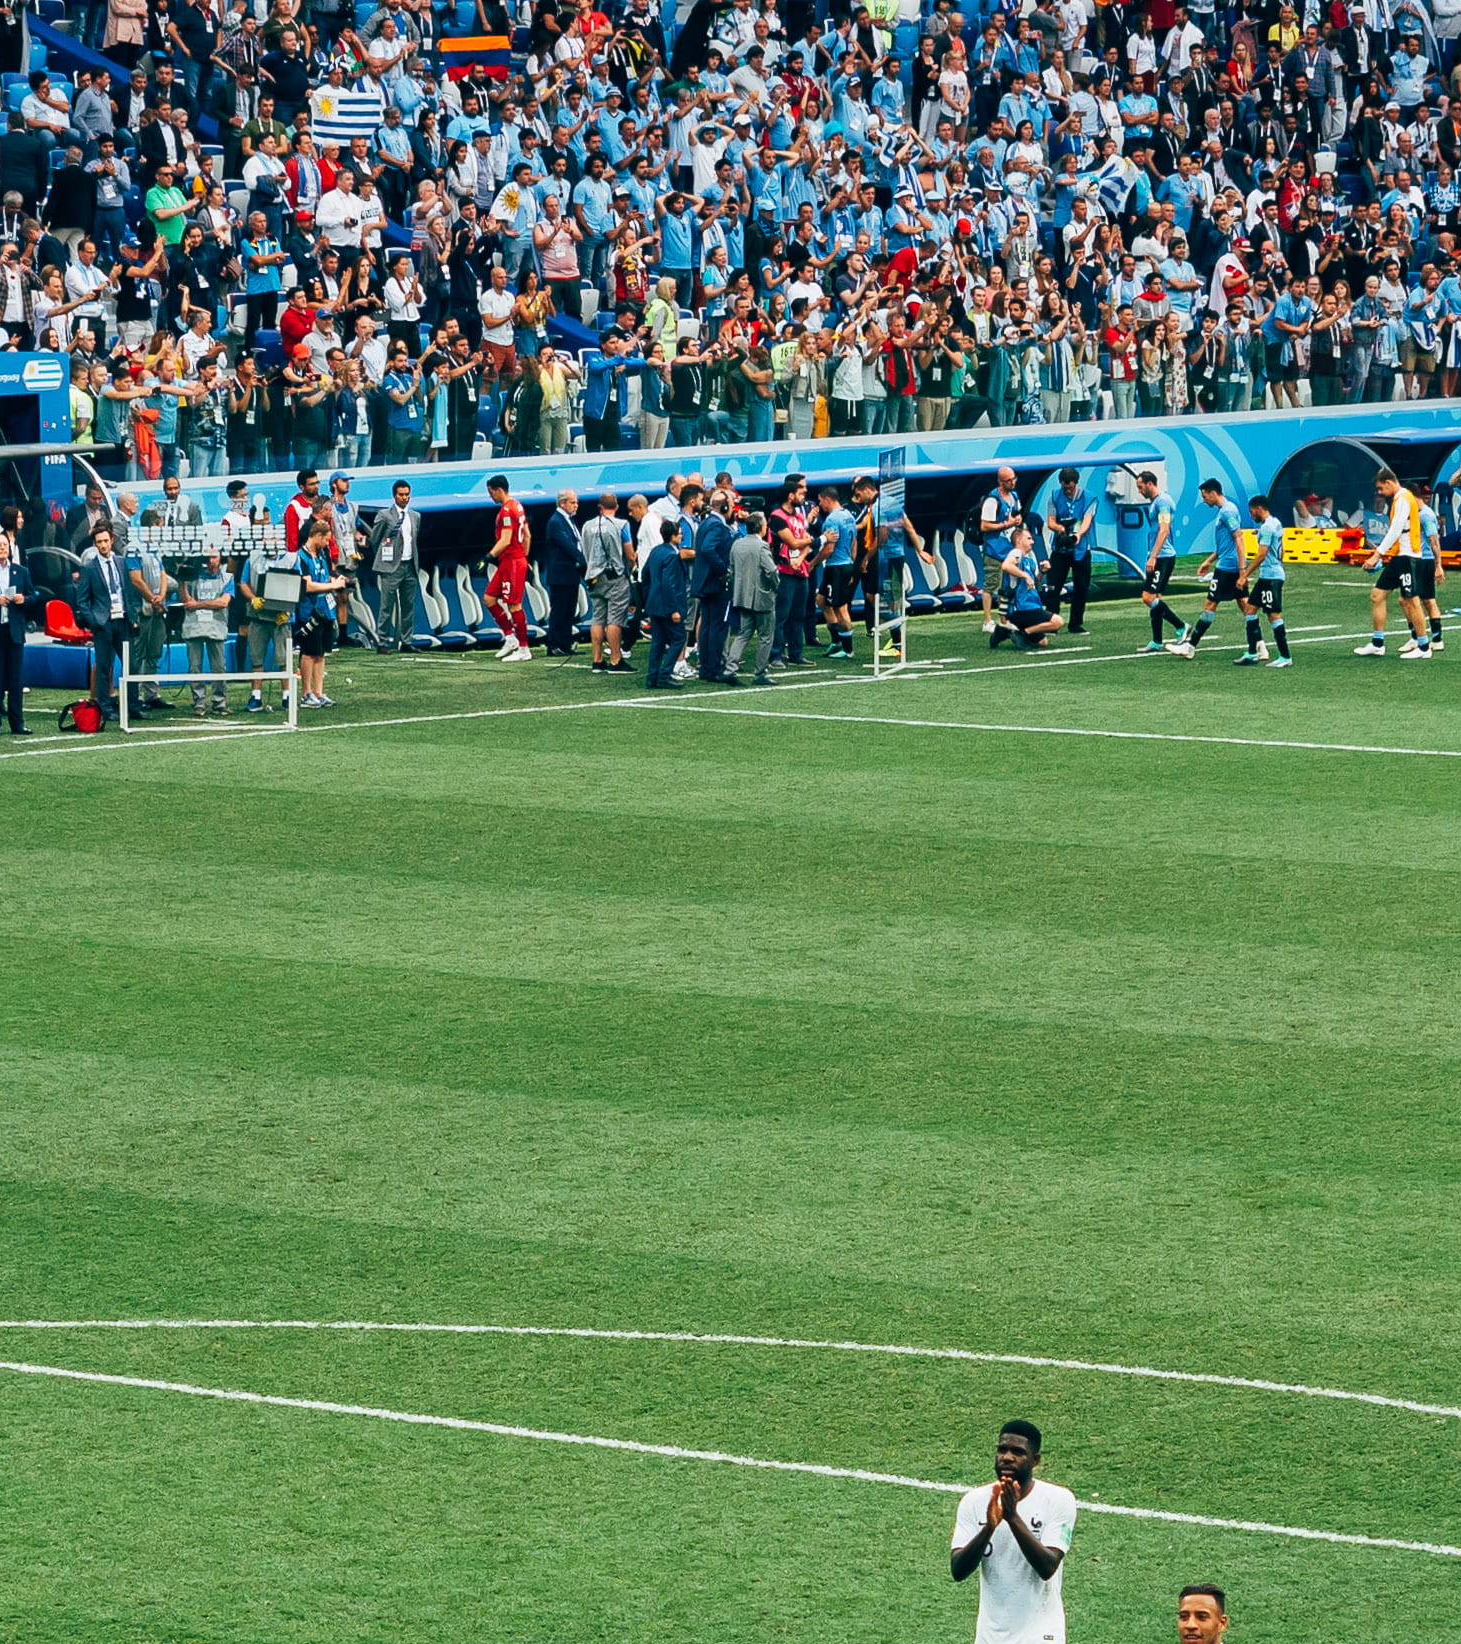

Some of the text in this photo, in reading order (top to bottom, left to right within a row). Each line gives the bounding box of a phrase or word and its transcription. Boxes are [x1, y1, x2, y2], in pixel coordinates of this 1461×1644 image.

[45, 454, 67, 466] FIFA
[1153, 570, 1160, 583] 3
[1399, 573, 1411, 587] 19
[1261, 590, 1273, 604] 20
